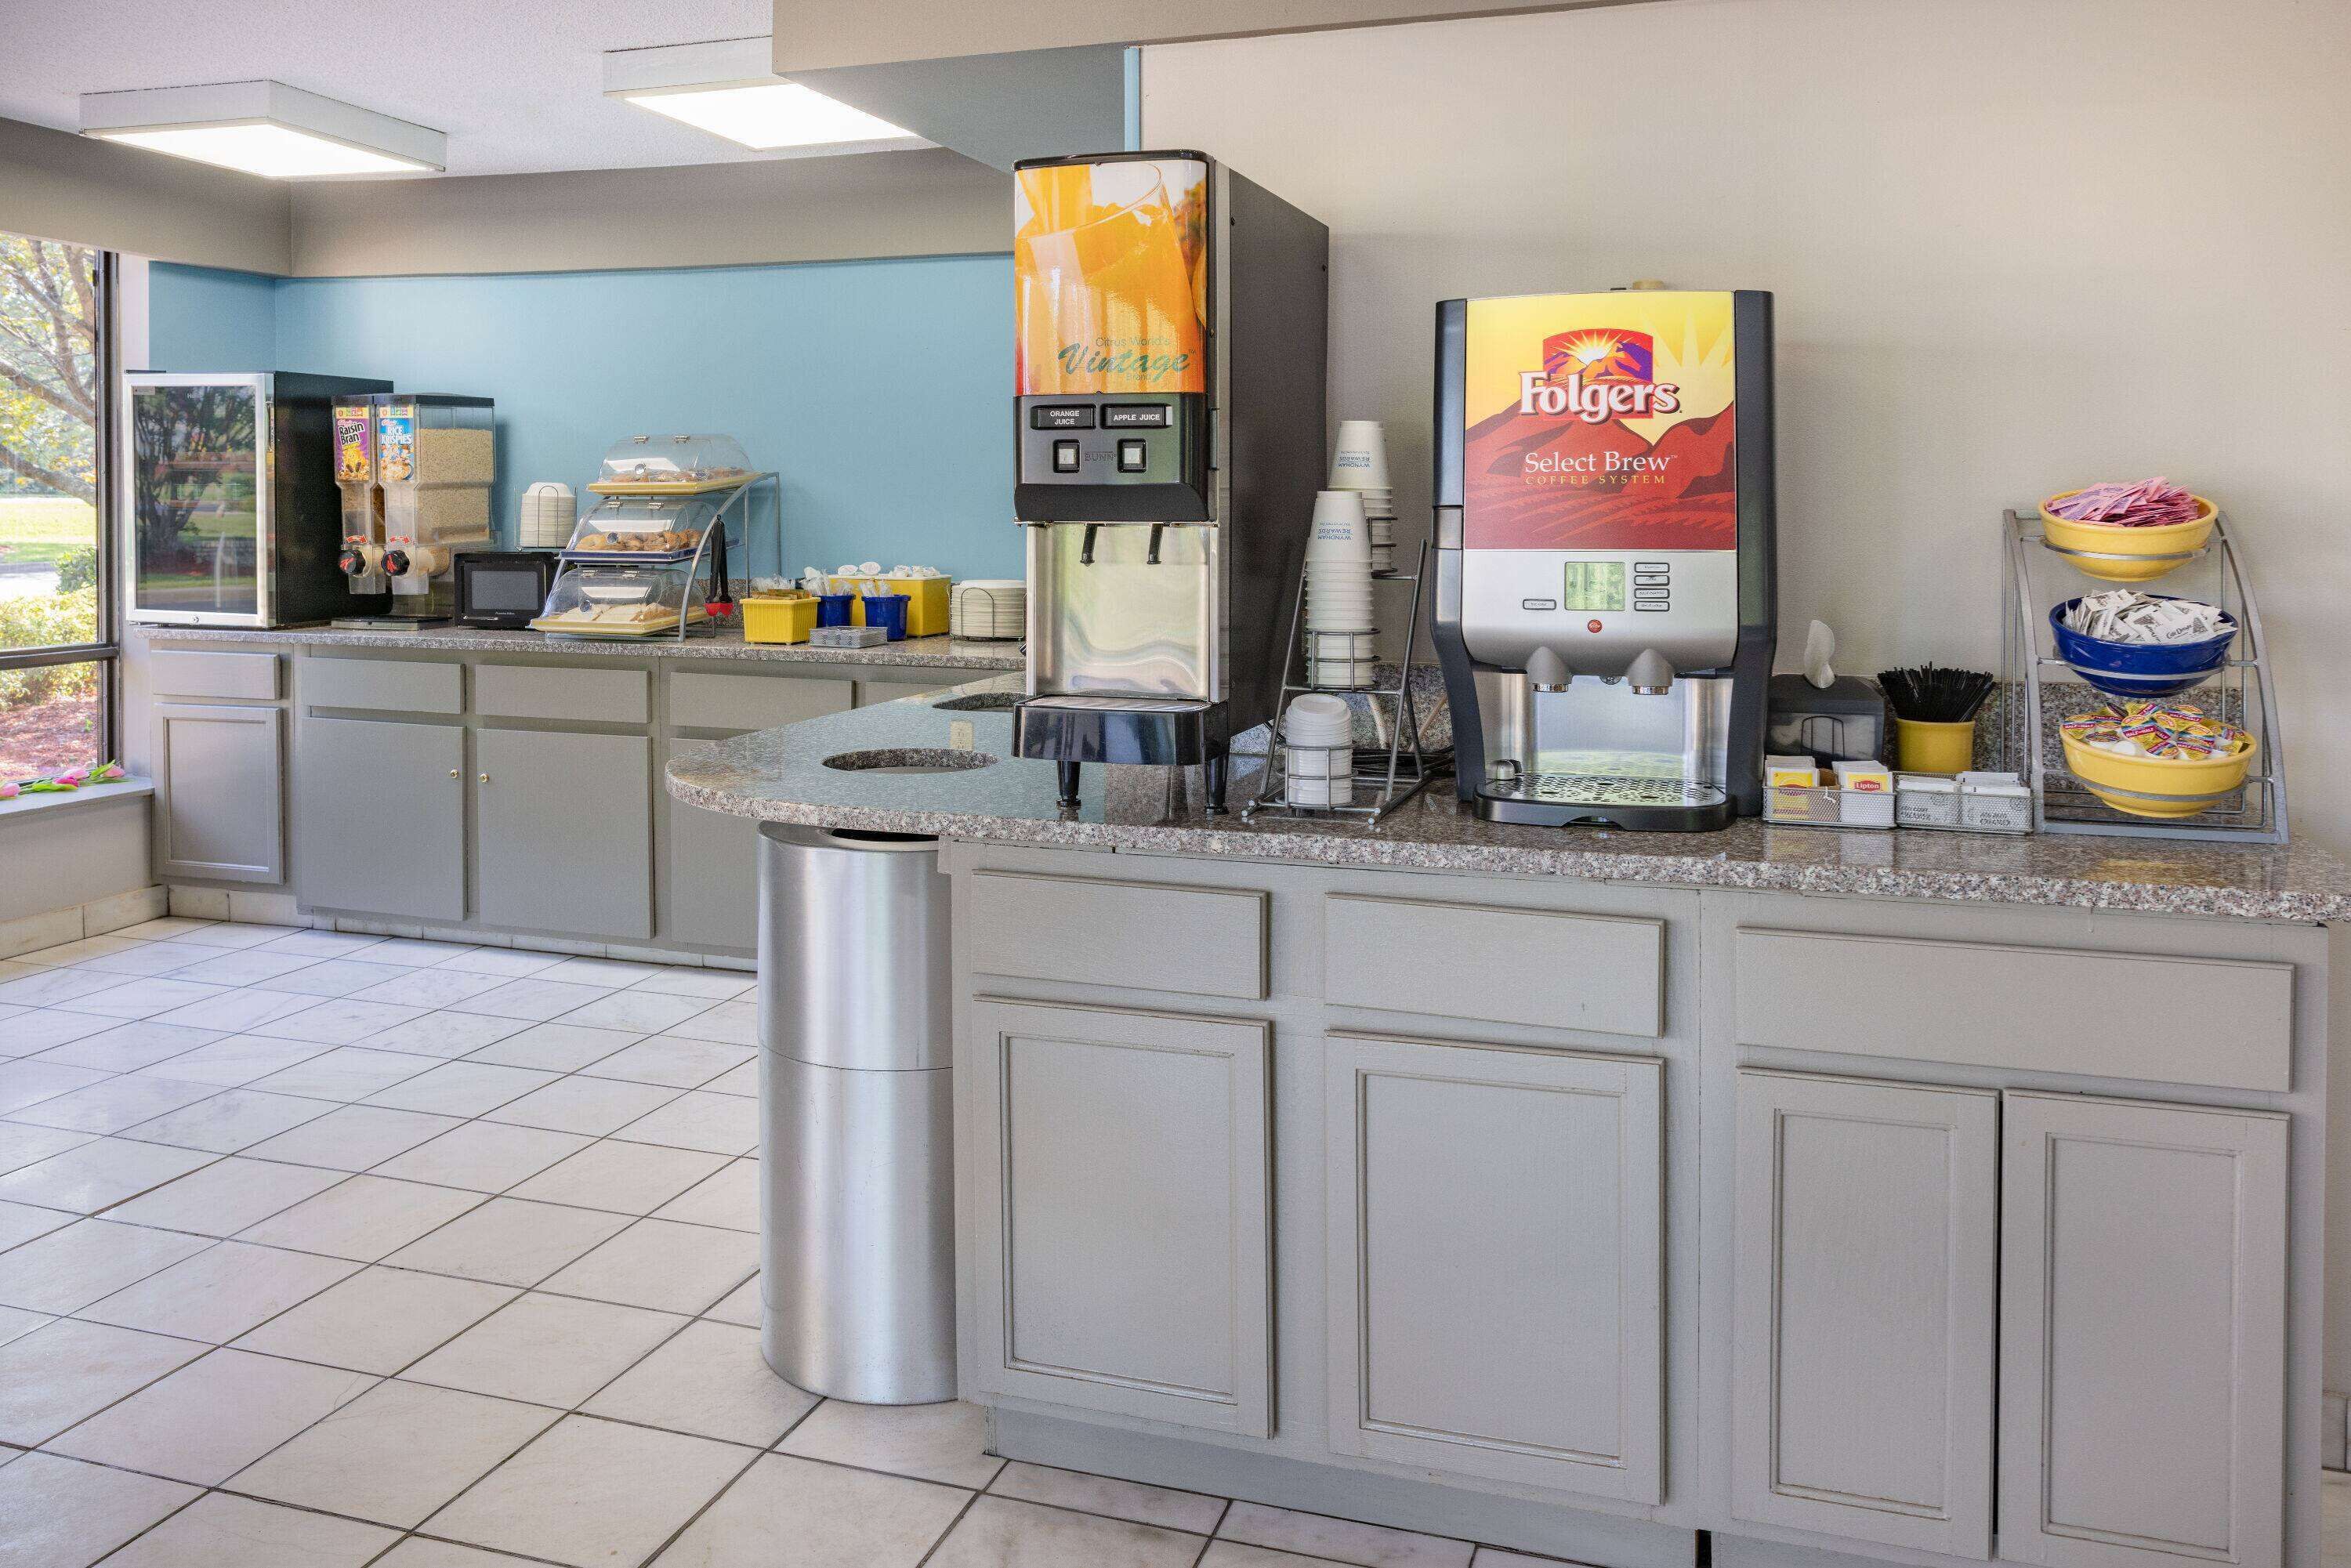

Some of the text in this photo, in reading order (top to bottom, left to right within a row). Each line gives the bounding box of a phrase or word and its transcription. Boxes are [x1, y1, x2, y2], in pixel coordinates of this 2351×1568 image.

[1096, 336, 1170, 347] Citrus World's
[1058, 342, 1190, 382] Vintage
[1519, 371, 1680, 425] Folgers
[339, 423, 364, 436] Raisin
[386, 425, 404, 436] RICE
[340, 433, 360, 445] Bran
[1525, 451, 1596, 473] Select
[1603, 451, 1671, 472] Brew
[1526, 475, 1665, 485] COFFEE SYSTEM
[1856, 782, 1879, 791] Lipton
